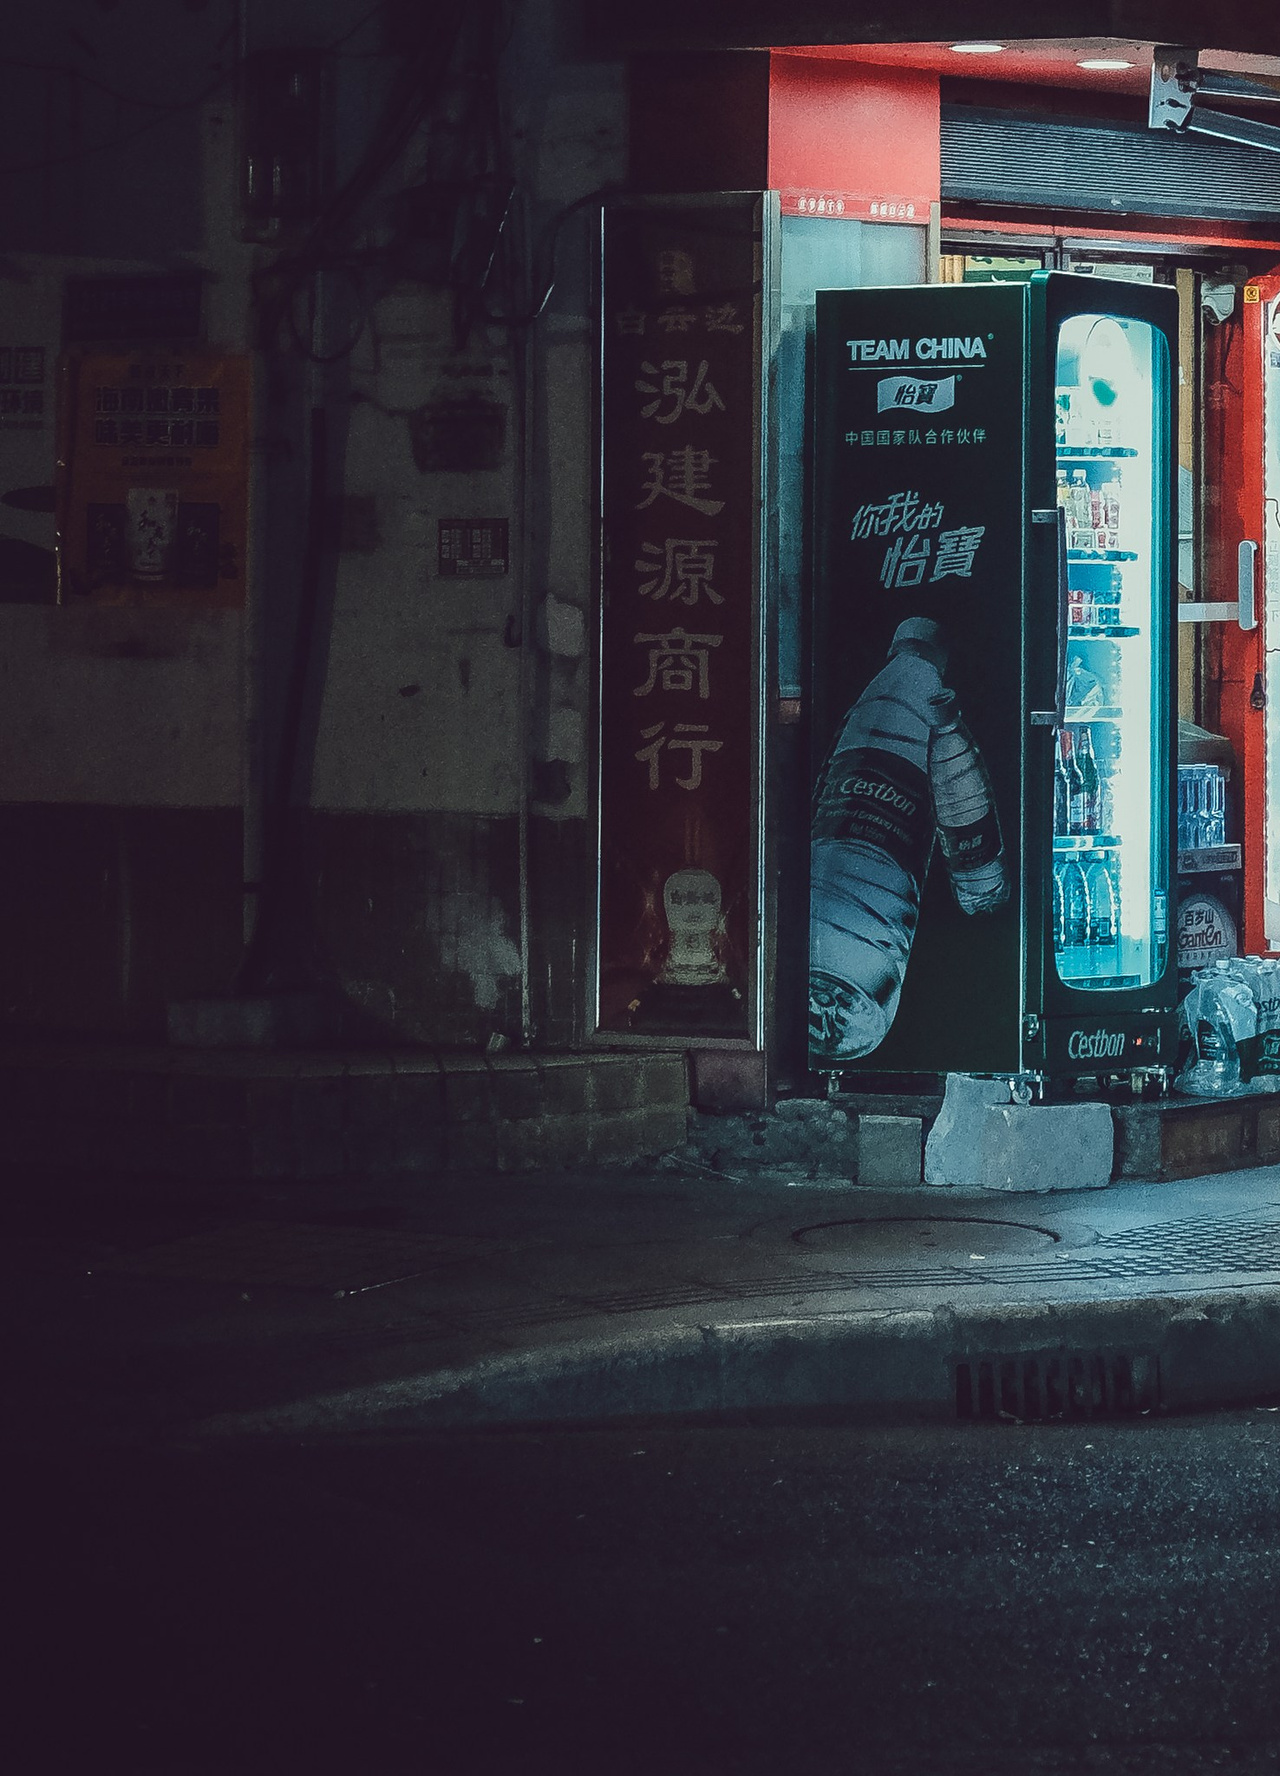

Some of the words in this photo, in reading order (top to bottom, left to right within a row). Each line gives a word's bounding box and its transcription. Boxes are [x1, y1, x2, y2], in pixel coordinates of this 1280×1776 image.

[846, 339, 909, 361] TEAM
[915, 337, 987, 360] CHINA
[893, 382, 939, 406] 怡寶
[845, 428, 987, 447] 中国国家队合作伙伴
[851, 490, 945, 541] 你我的
[878, 525, 986, 590] 怡寶
[634, 358, 727, 792] 泓建源商行
[1184, 910, 1215, 927] 百岁山
[1177, 925, 1222, 950] Ganten
